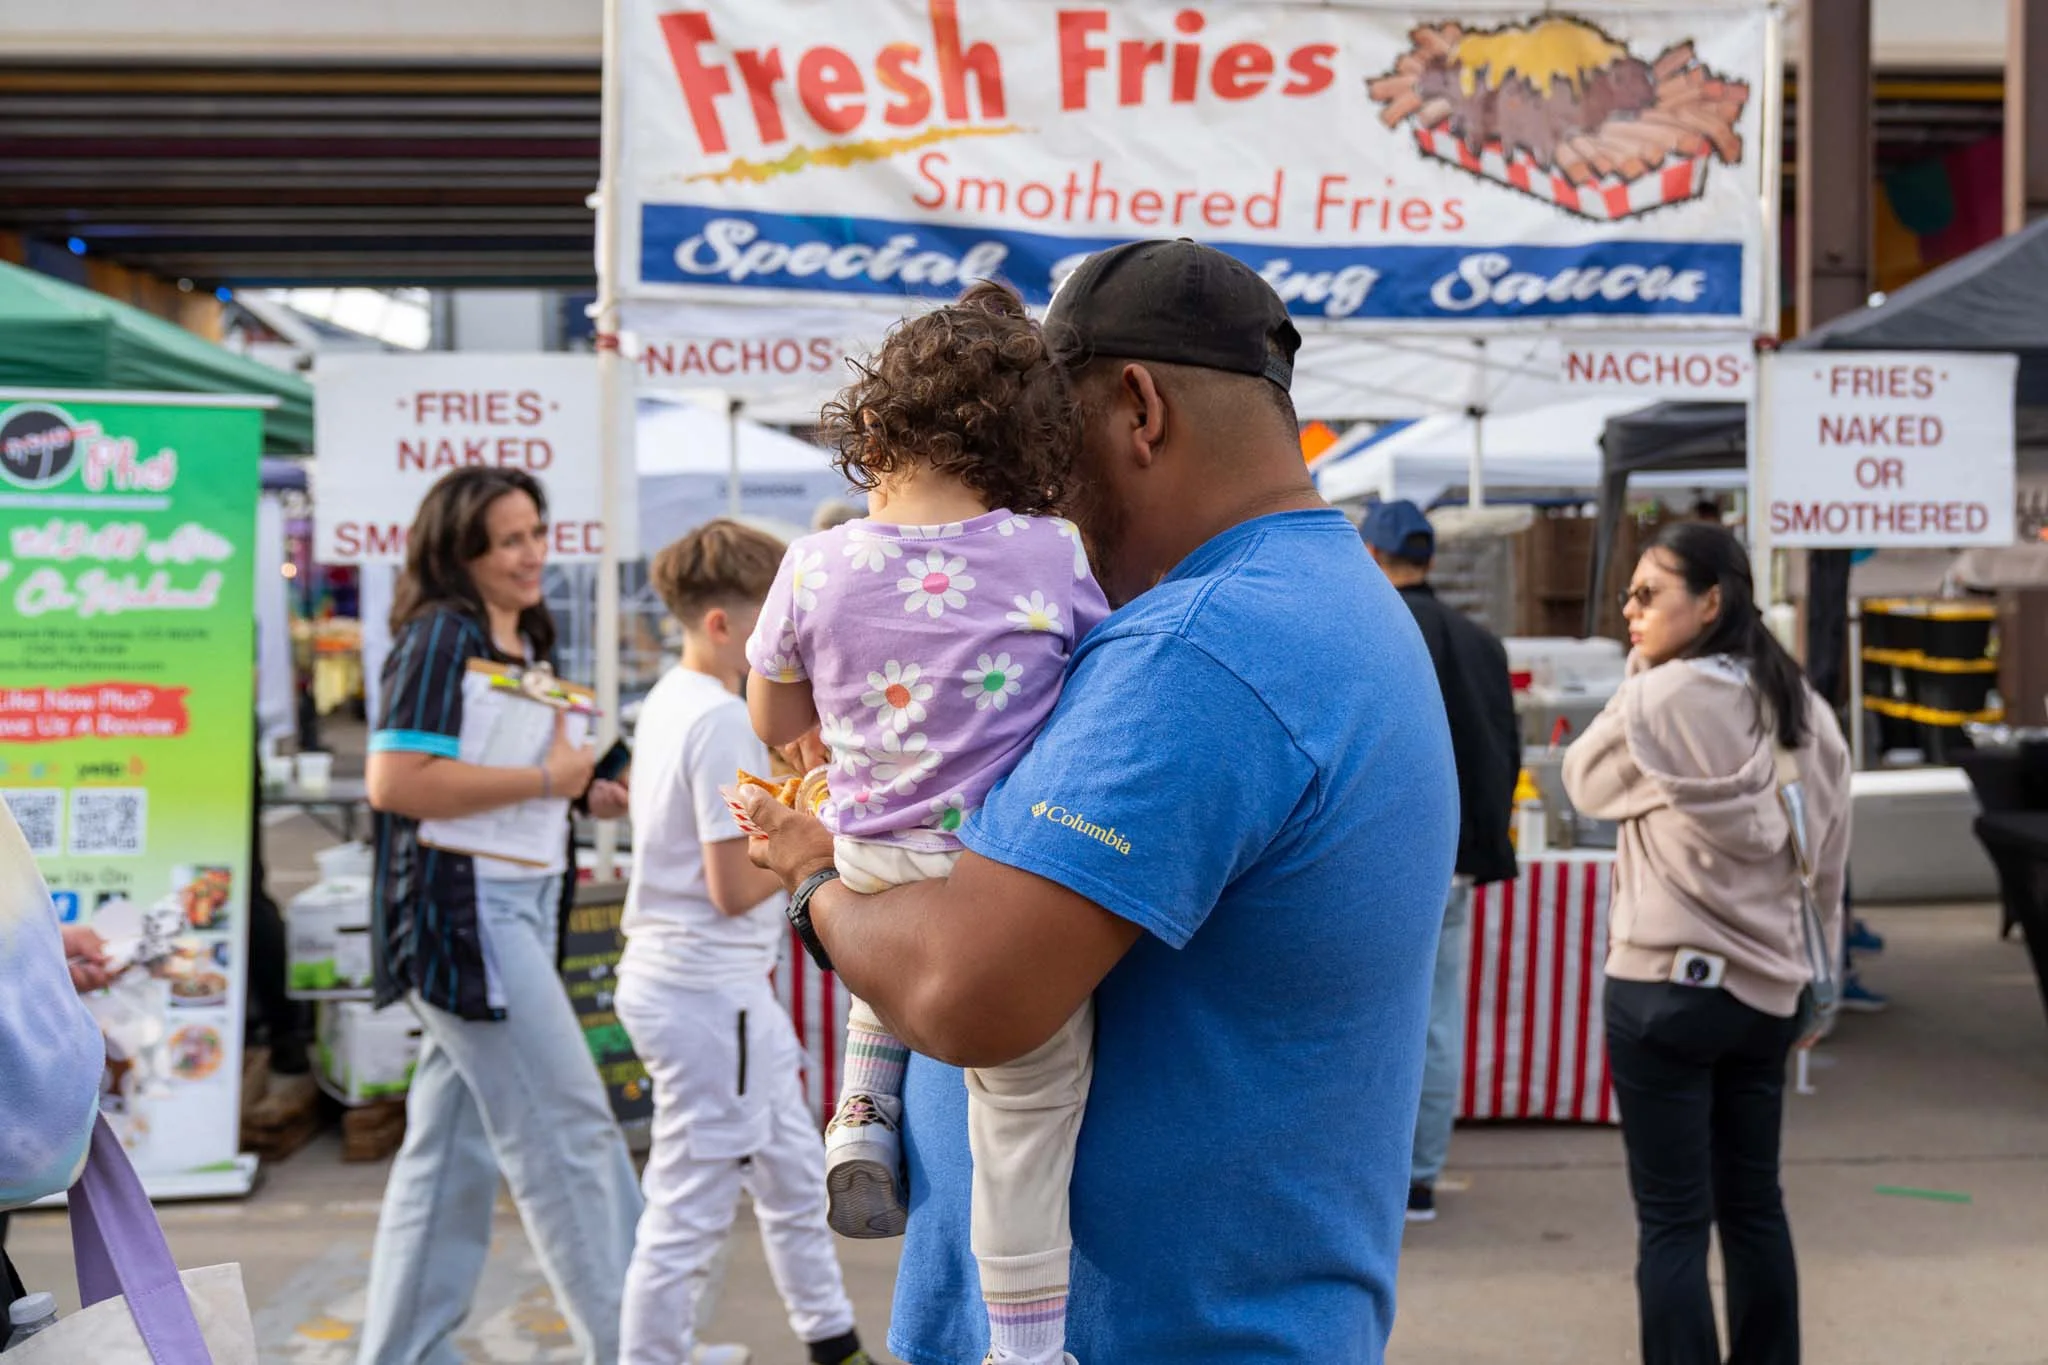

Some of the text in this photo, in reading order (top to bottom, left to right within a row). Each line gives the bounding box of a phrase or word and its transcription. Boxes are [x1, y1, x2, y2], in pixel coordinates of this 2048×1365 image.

[658, 0, 1340, 155] Fresh Fries
[912, 152, 1465, 231] Smothered Fries
[674, 217, 1009, 285] Special
[1430, 252, 1707, 311] Sauces
[1830, 365, 1935, 399] FRIES
[414, 390, 543, 426] FRIES
[1819, 415, 1944, 447] NAKED
[397, 437, 554, 471] NAKED
[1855, 458, 1904, 489] OR
[1770, 501, 1989, 534] SMOTHERED
[1046, 805, 1132, 855] Columbia
